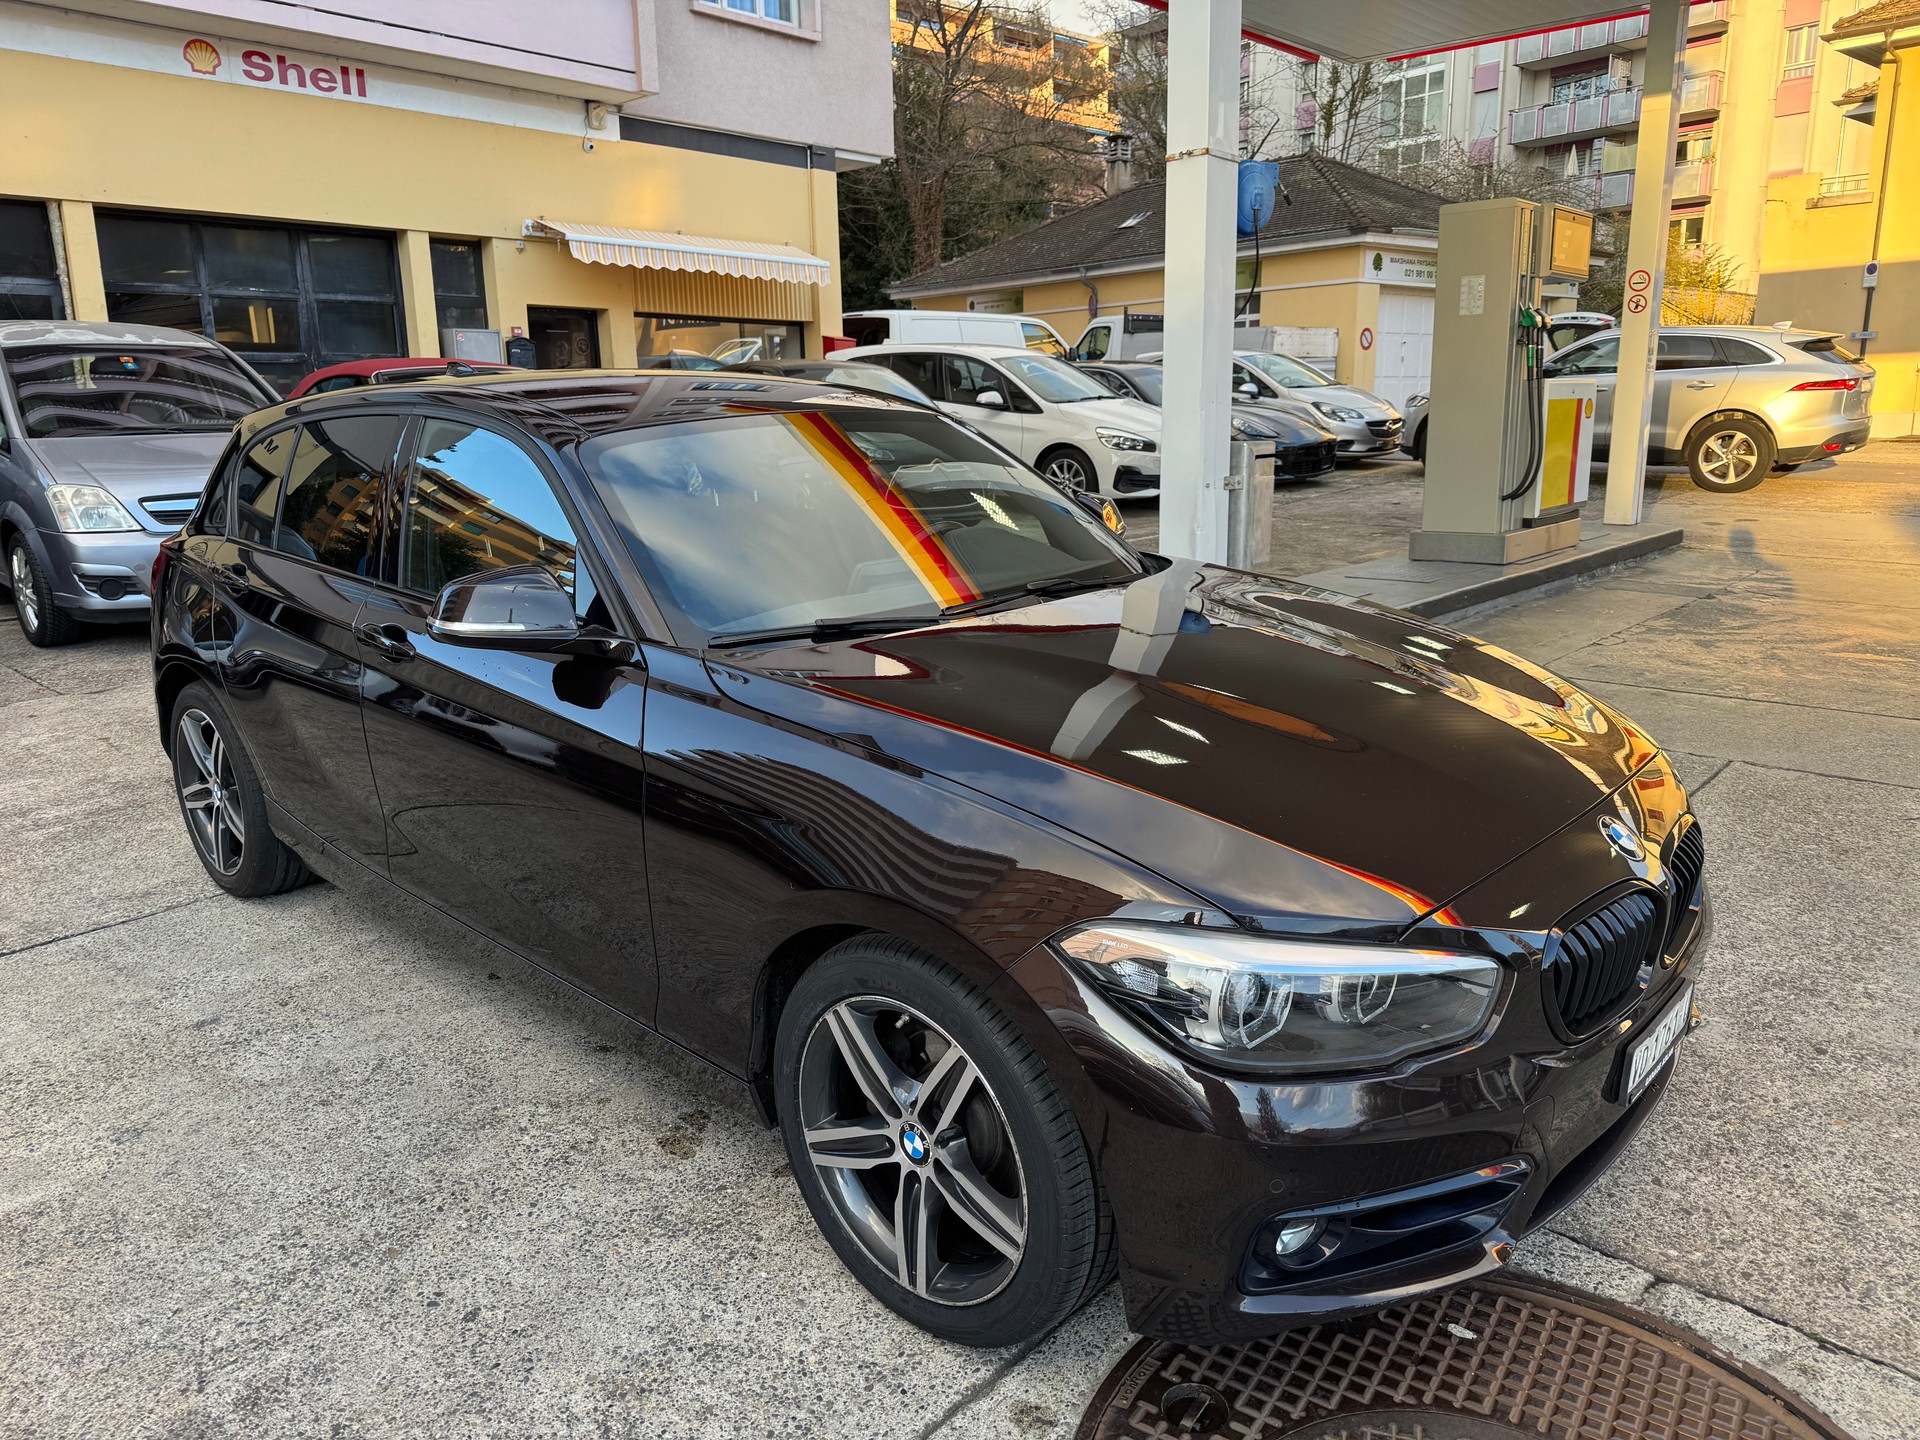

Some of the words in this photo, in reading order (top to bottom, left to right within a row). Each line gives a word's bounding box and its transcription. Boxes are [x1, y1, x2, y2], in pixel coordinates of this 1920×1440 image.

[242, 50, 367, 97] Shell
[1390, 257, 1416, 265] MAKSHANA
[1405, 269, 1414, 277] 021
[1102, 939, 1116, 947] BMW
[904, 1124, 930, 1148] BMW
